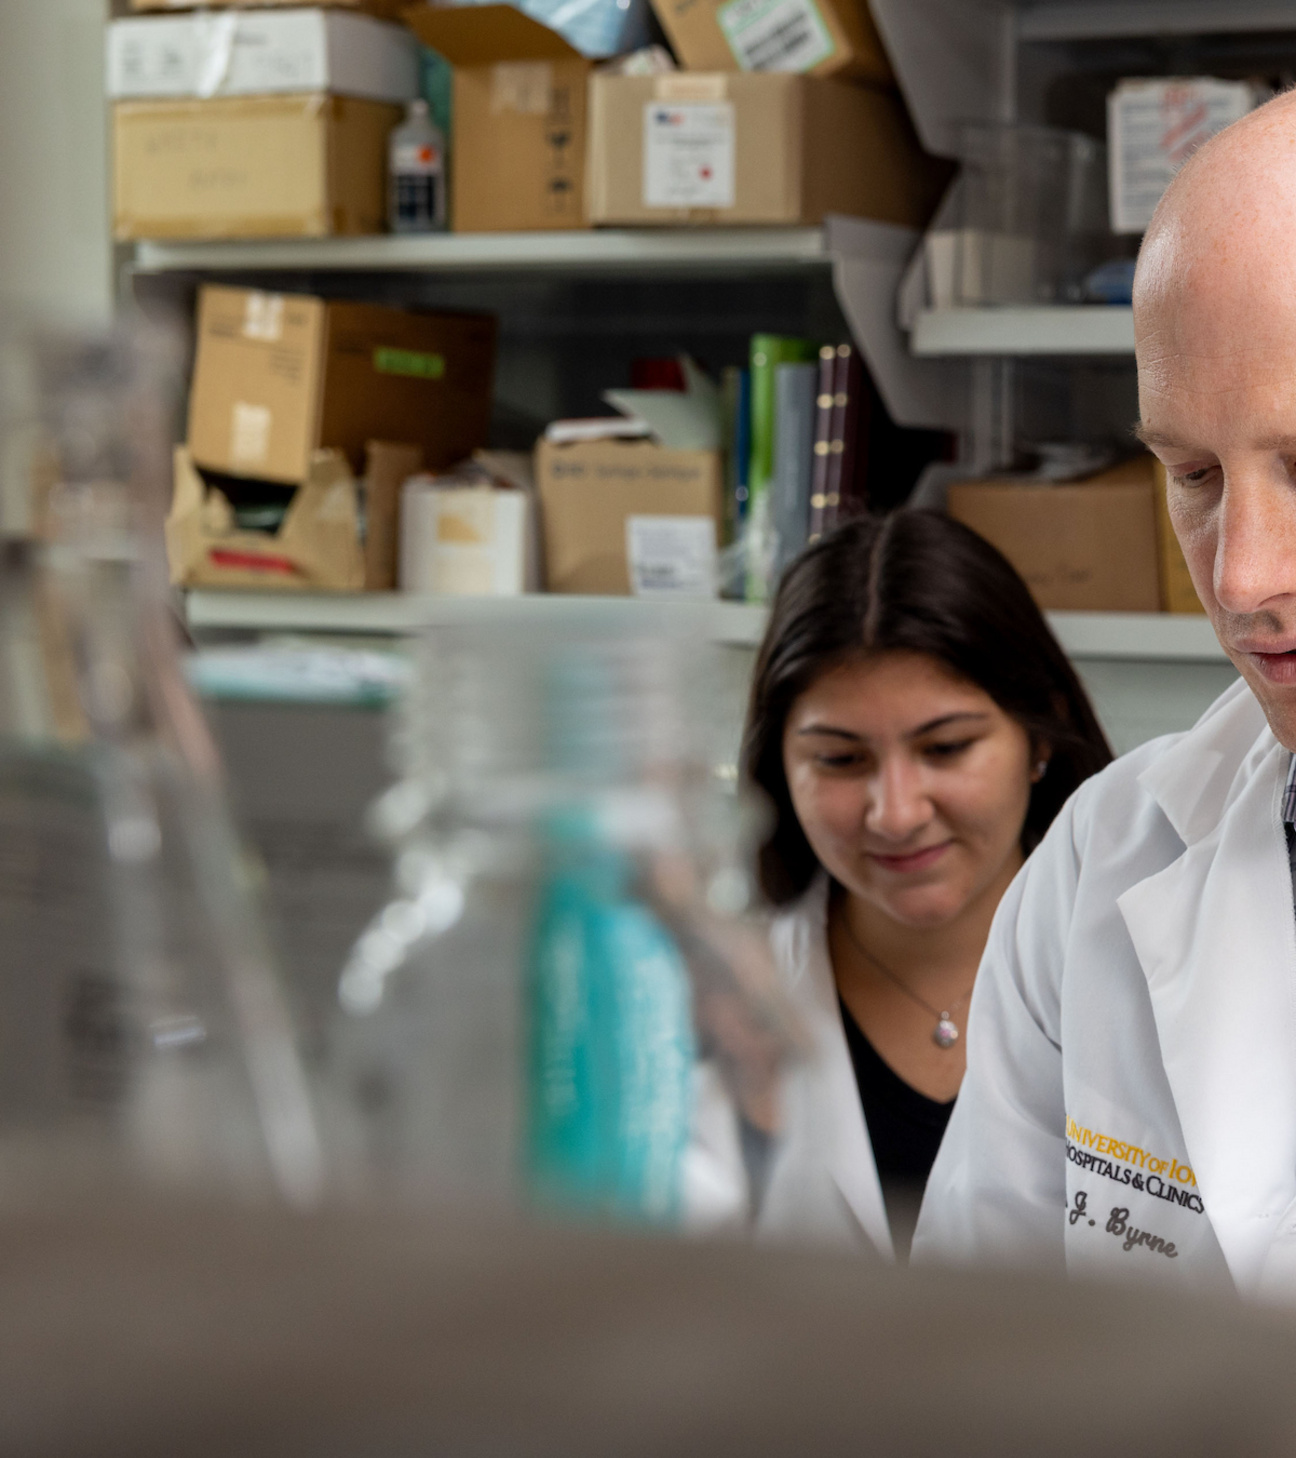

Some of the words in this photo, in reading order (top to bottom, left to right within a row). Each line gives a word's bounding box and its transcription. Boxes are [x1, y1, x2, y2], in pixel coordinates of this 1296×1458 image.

[1066, 1114, 1150, 1168] UNIVERSITY
[1132, 1172, 1145, 1192] &
[1146, 1175, 1205, 1214] CLINICS
[1106, 1207, 1179, 1258] Byrne
